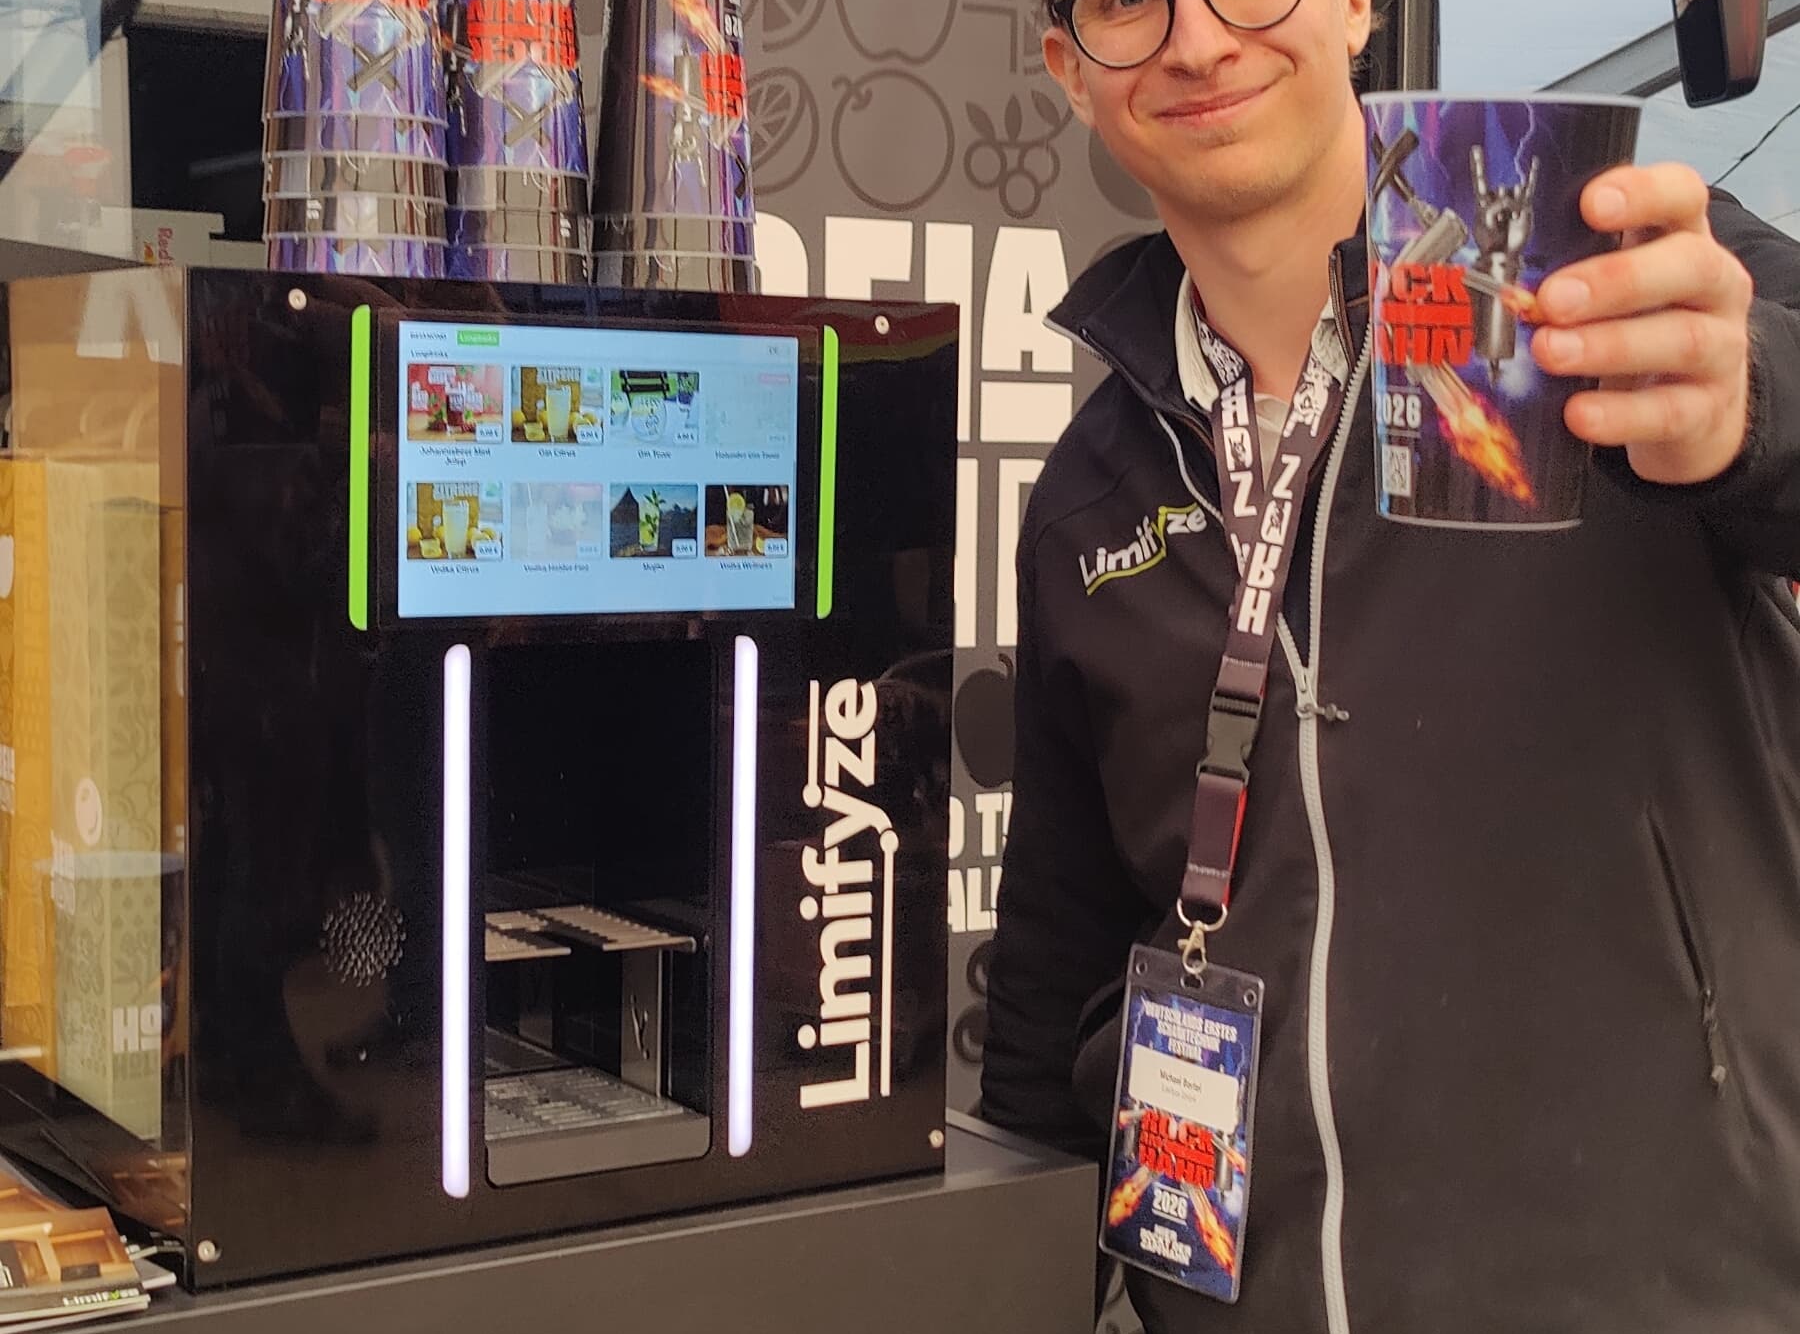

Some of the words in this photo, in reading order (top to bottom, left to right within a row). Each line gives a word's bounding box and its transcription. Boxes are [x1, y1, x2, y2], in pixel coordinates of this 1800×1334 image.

[1079, 503, 1208, 592] Limifyze
[800, 678, 898, 1109] Limifyze
[1141, 1108, 1214, 1155] ROCK
[1153, 1190, 1188, 1218] 2026
